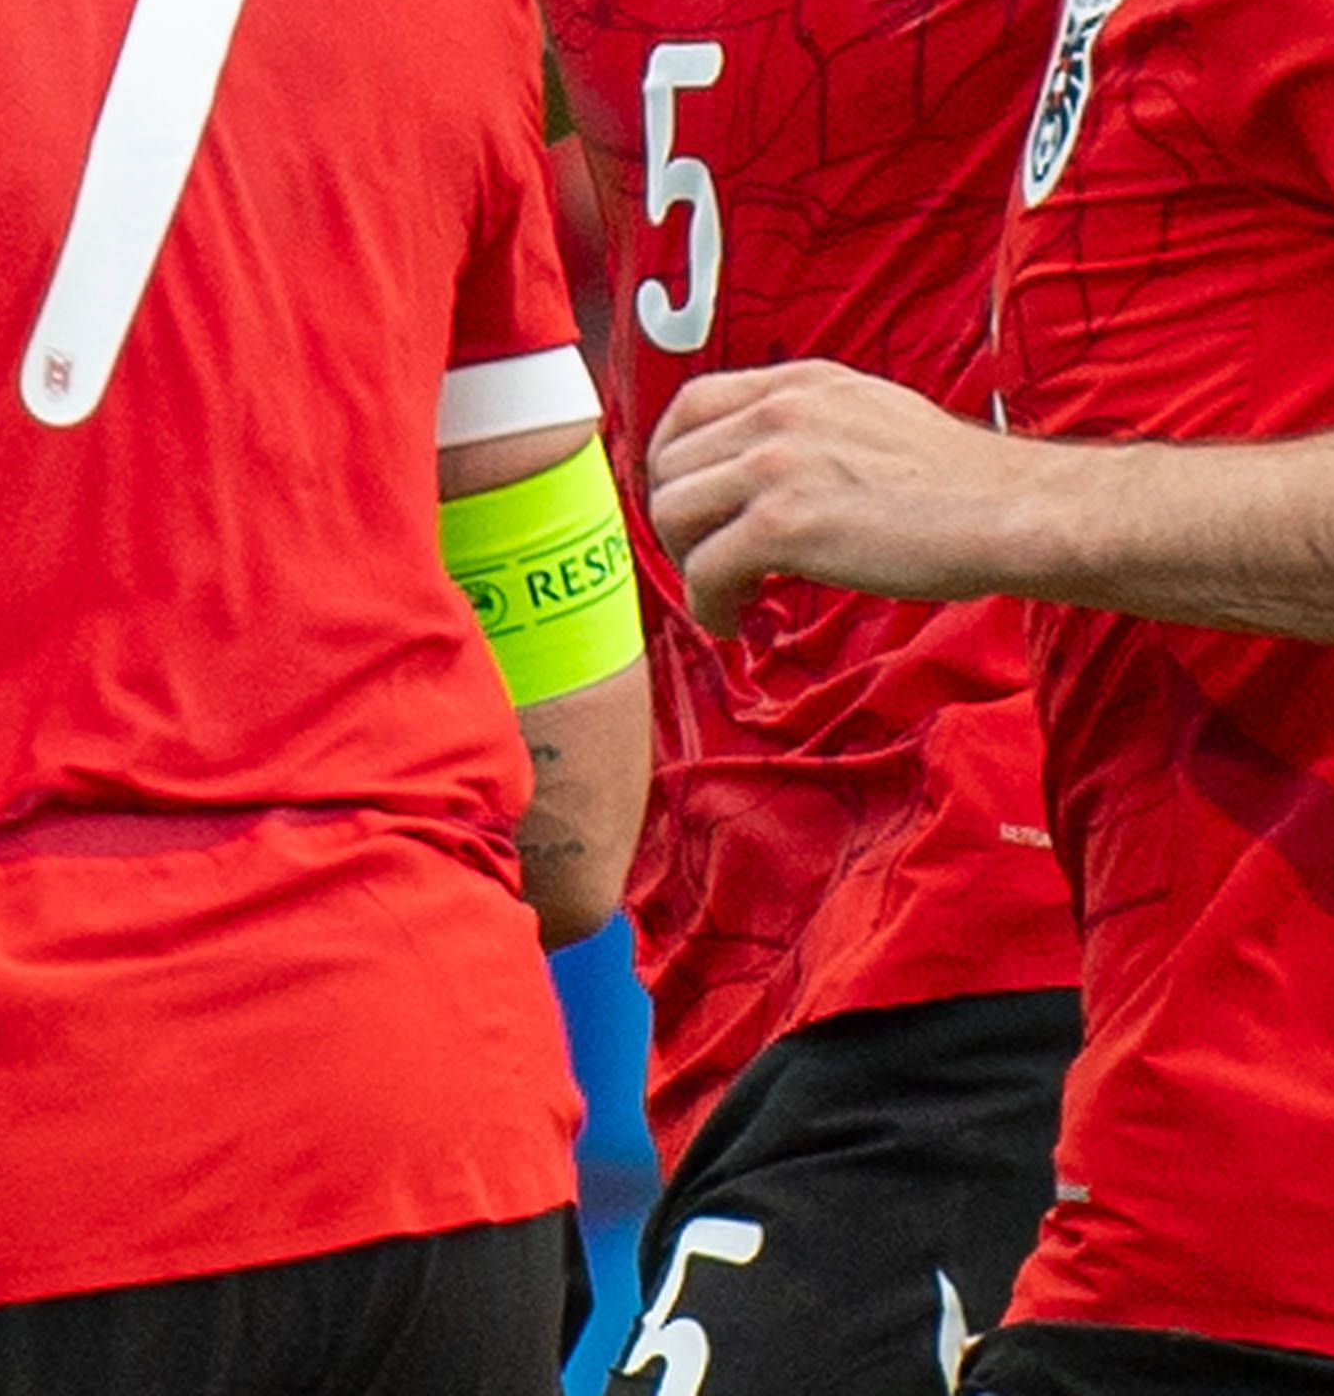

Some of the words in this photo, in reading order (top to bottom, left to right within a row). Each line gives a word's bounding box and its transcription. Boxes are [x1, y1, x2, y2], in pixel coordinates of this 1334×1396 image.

[636, 41, 723, 353] 5
[525, 526, 628, 609] RESP
[623, 1216, 764, 1396] 5
